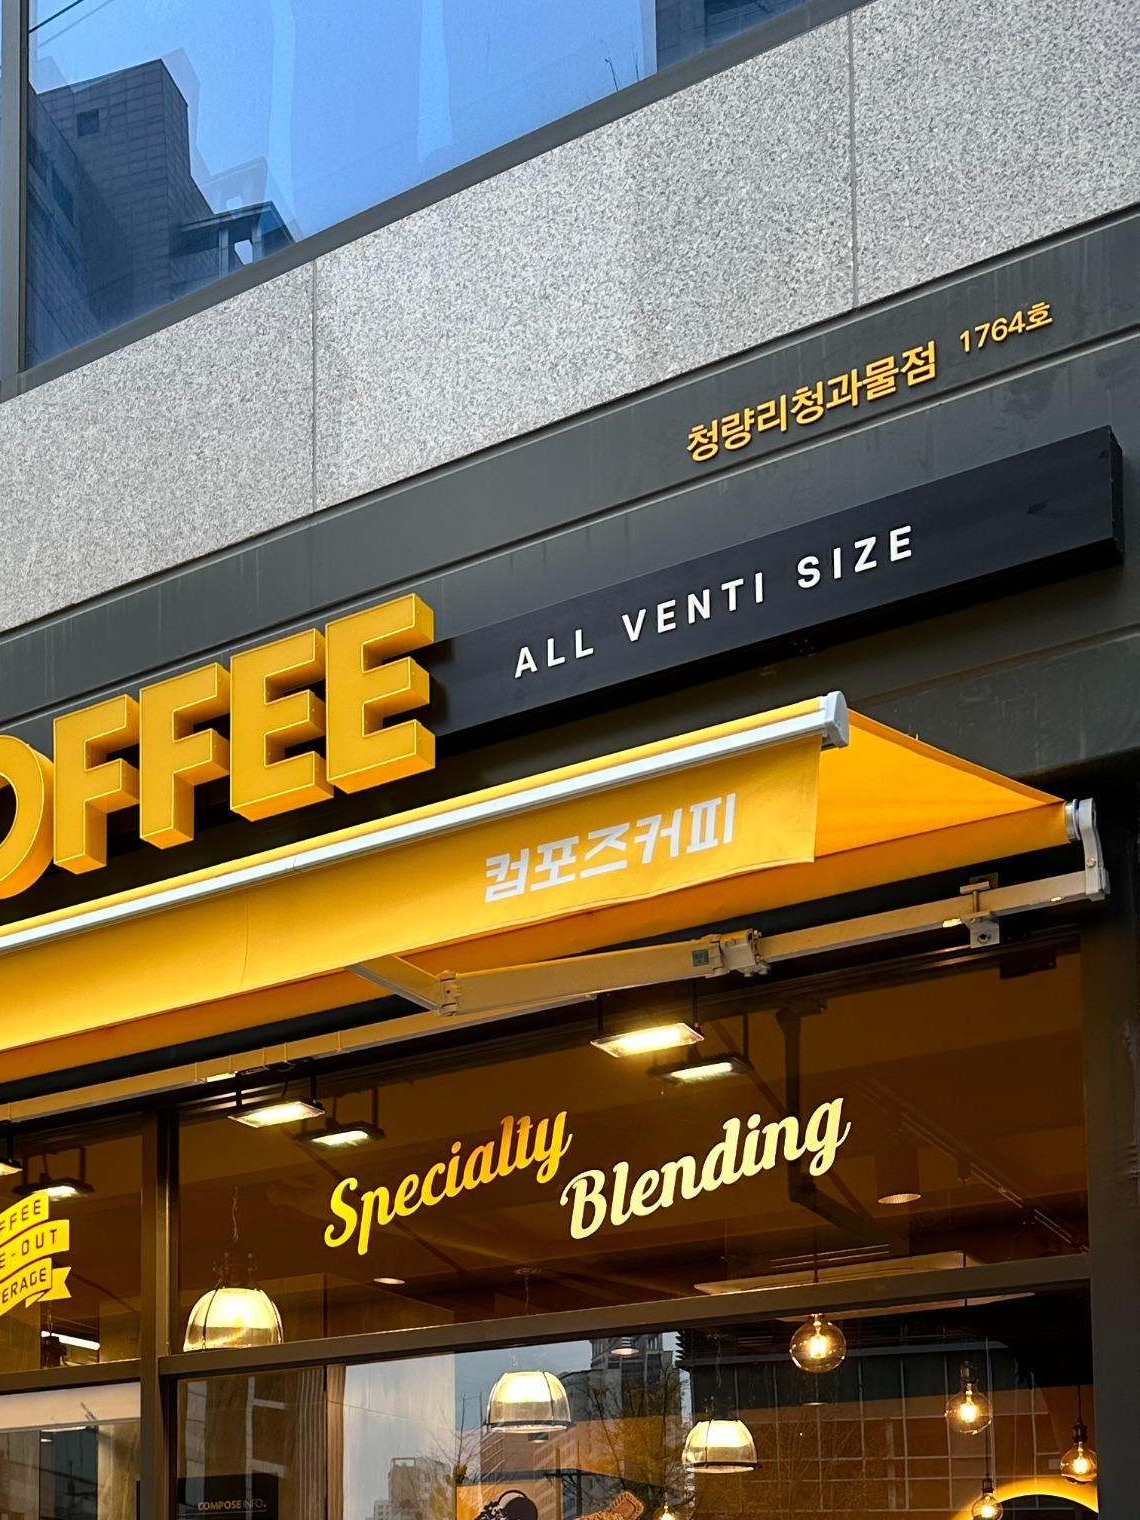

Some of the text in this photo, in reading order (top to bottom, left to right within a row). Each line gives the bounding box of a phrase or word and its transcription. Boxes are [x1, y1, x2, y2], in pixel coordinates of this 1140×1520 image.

[687, 302, 1053, 462] 청량리청과물점 1764호
[514, 525, 912, 678] ALL VENTI SIZE
[485, 794, 735, 903] 컴포즈커피
[323, 1111, 572, 1256] Specialty
[560, 1098, 852, 1240] Blending
[198, 1500, 241, 1511] COMPOSE
